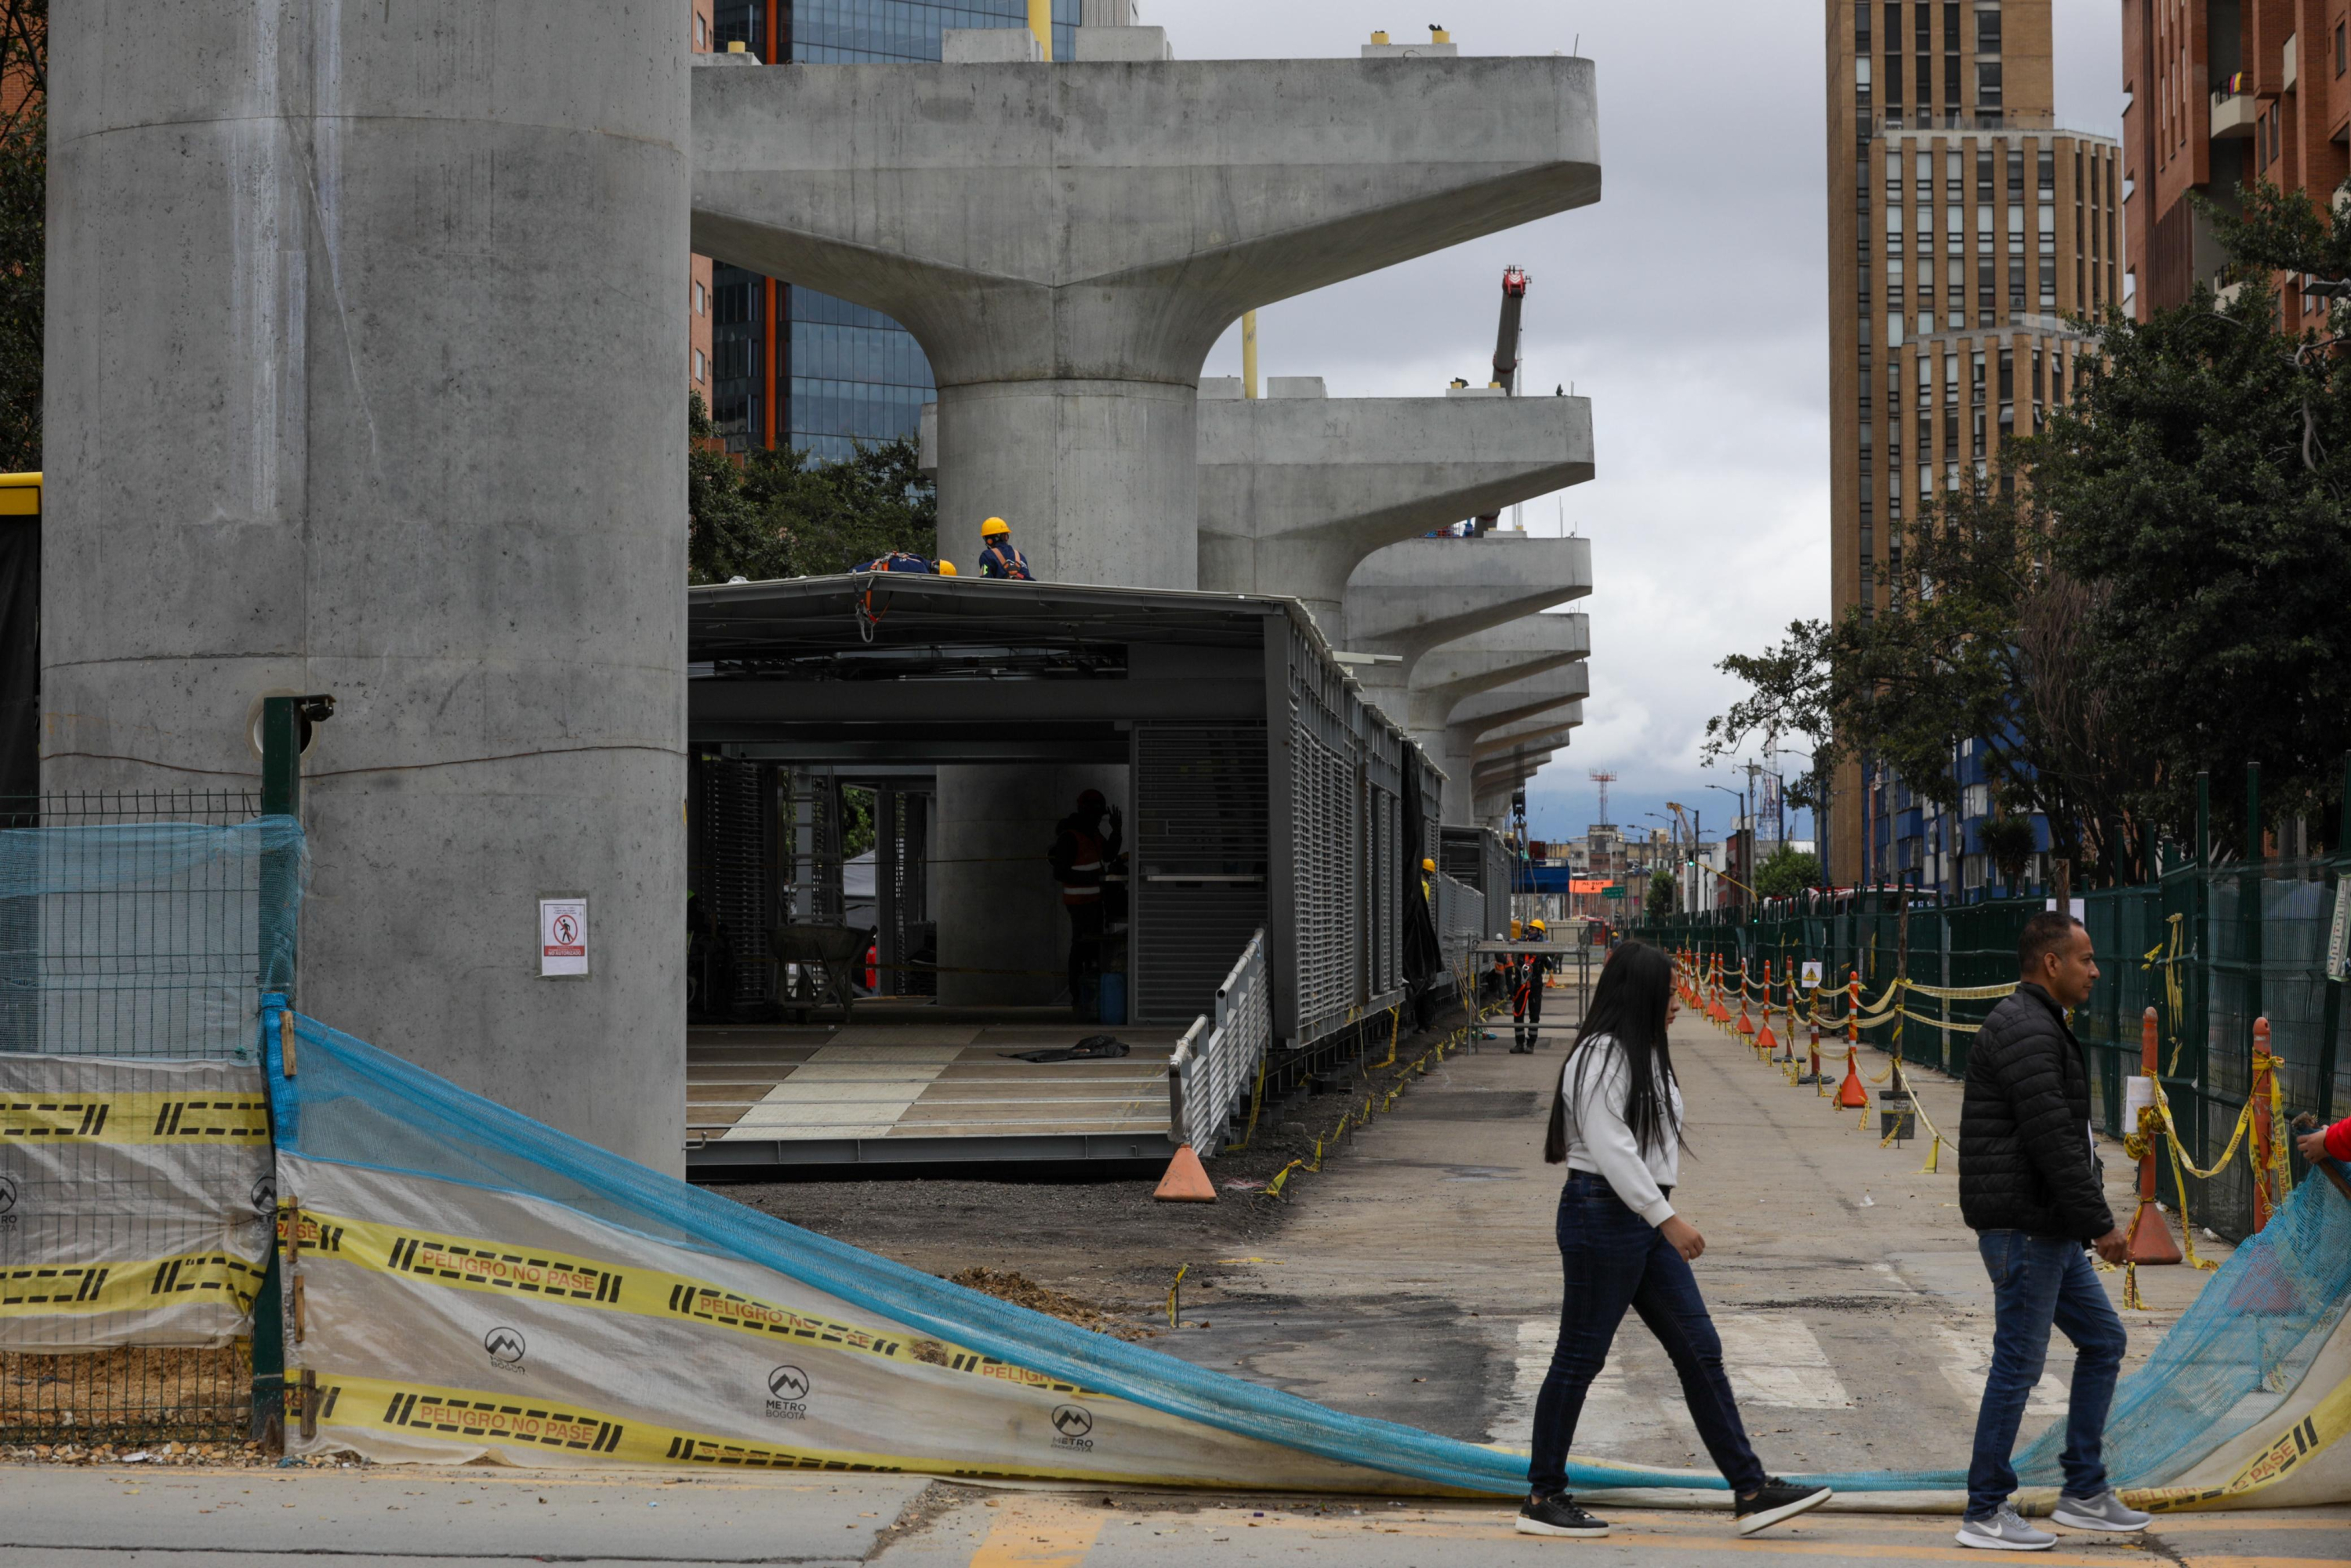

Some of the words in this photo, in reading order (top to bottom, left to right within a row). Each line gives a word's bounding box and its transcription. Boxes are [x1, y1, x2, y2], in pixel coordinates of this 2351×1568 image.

[423, 1250, 506, 1279] PELIGRO
[513, 1265, 541, 1283] NO
[547, 1270, 596, 1290] PASE
[700, 1297, 783, 1323] PELIGRO
[766, 1399, 807, 1411] METRO
[421, 1406, 506, 1429] PELIGRO
[511, 1415, 540, 1433] NO
[545, 1421, 595, 1443] PASE
[1052, 1436, 1094, 1447] METRO
[2250, 1442, 2296, 1483] PASE
